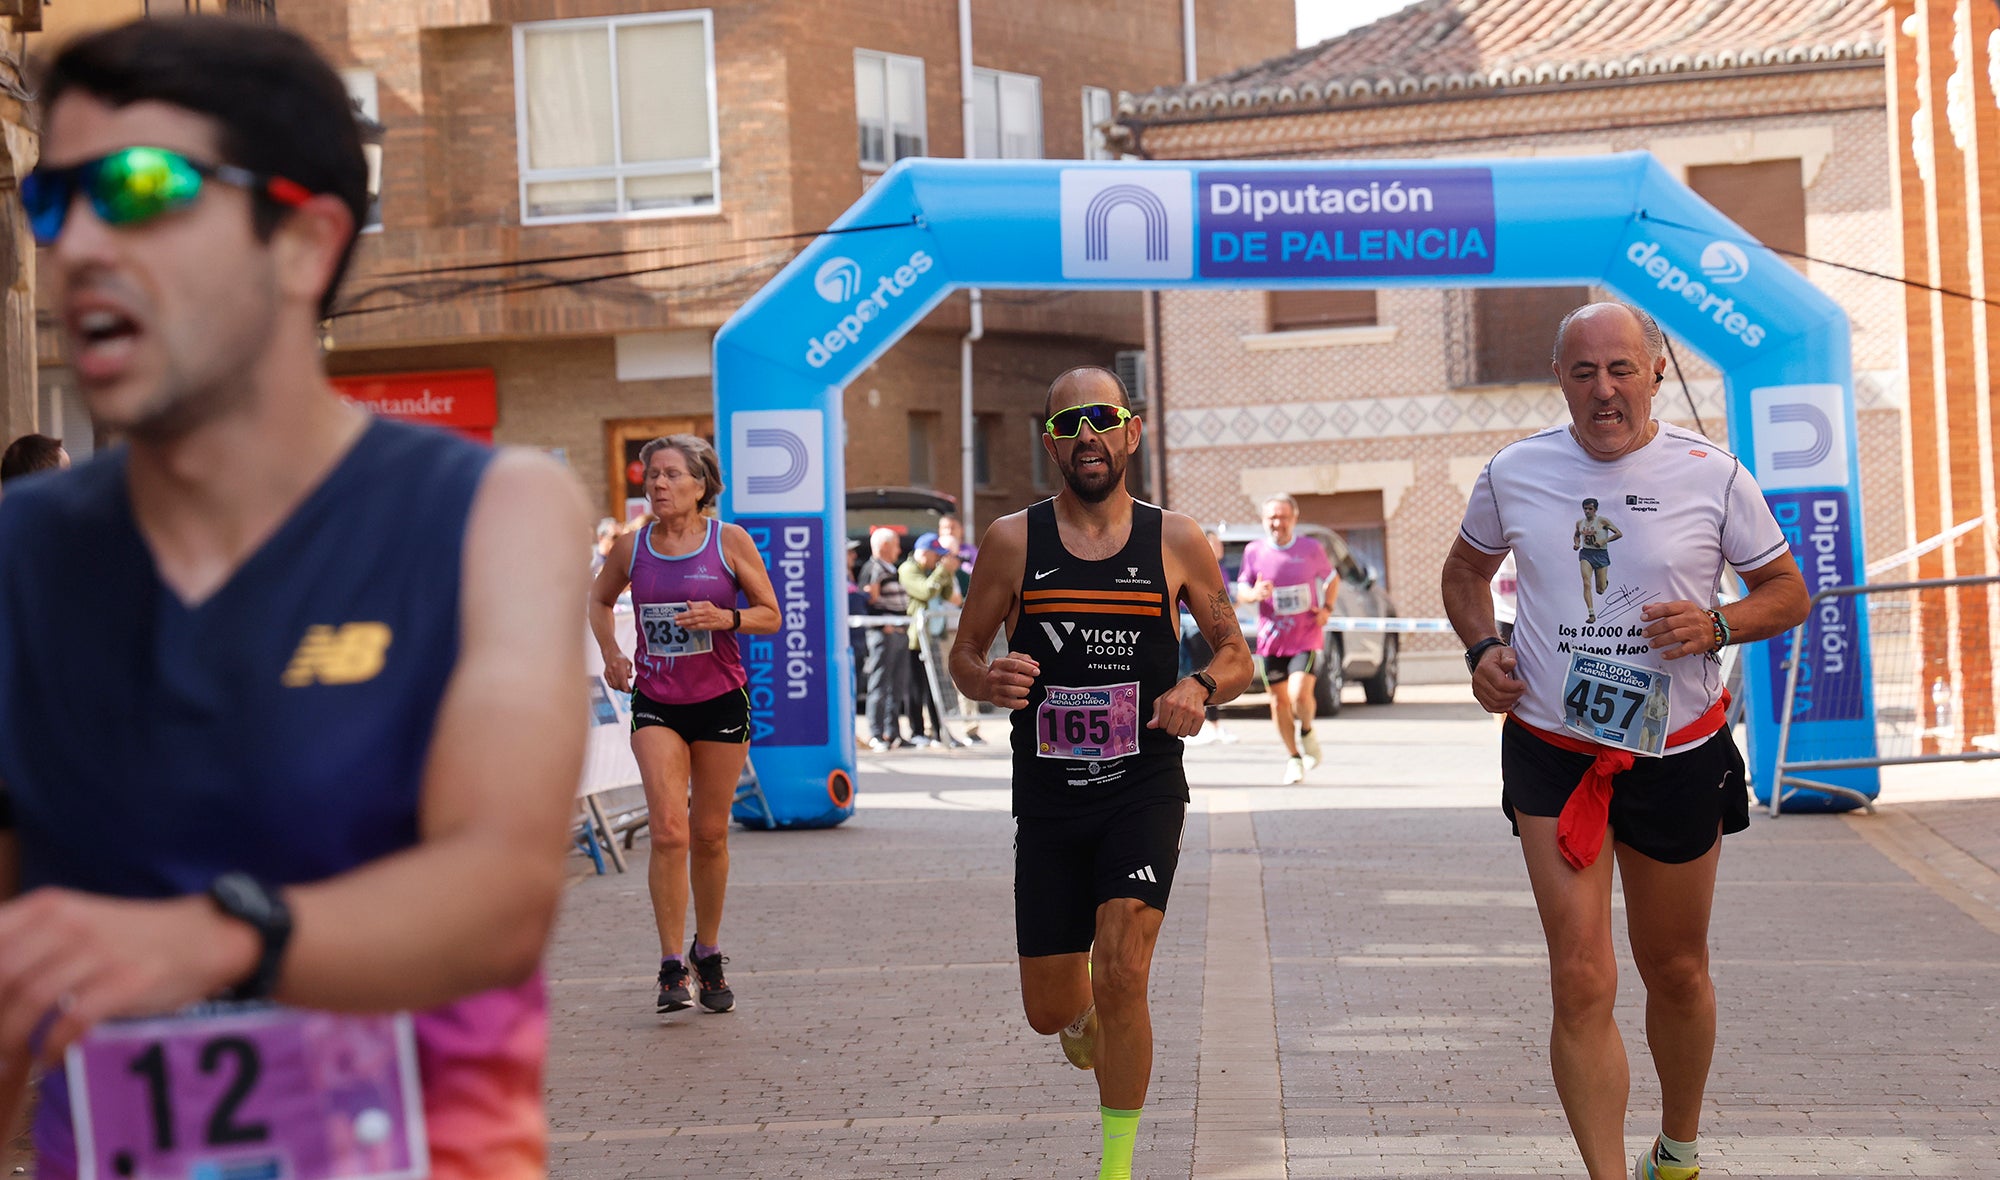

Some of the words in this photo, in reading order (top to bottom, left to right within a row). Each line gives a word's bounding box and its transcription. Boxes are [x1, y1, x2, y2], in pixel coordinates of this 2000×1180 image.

[1211, 181, 1433, 221] Diputación
[1212, 231, 1267, 262] DE
[1281, 227, 1488, 261] PALENCIA
[805, 250, 933, 368] deportes
[1626, 241, 1766, 348] deportes
[779, 526, 813, 699] Diputación
[644, 620, 690, 644] 233
[1080, 629, 1141, 644] VICKY
[1559, 624, 1577, 638] Los
[1581, 626, 1623, 637] 10.000
[1627, 625, 1642, 637] de
[1086, 645, 1134, 656] FOODS
[1615, 643, 1649, 656] Haro
[1088, 663, 1131, 671] ATHLETICS
[1595, 662, 1631, 677] 10.000
[1058, 692, 1091, 701] 10.000
[1566, 679, 1645, 730] 457
[1043, 709, 1110, 745] 165
[129, 1035, 269, 1152] 12
